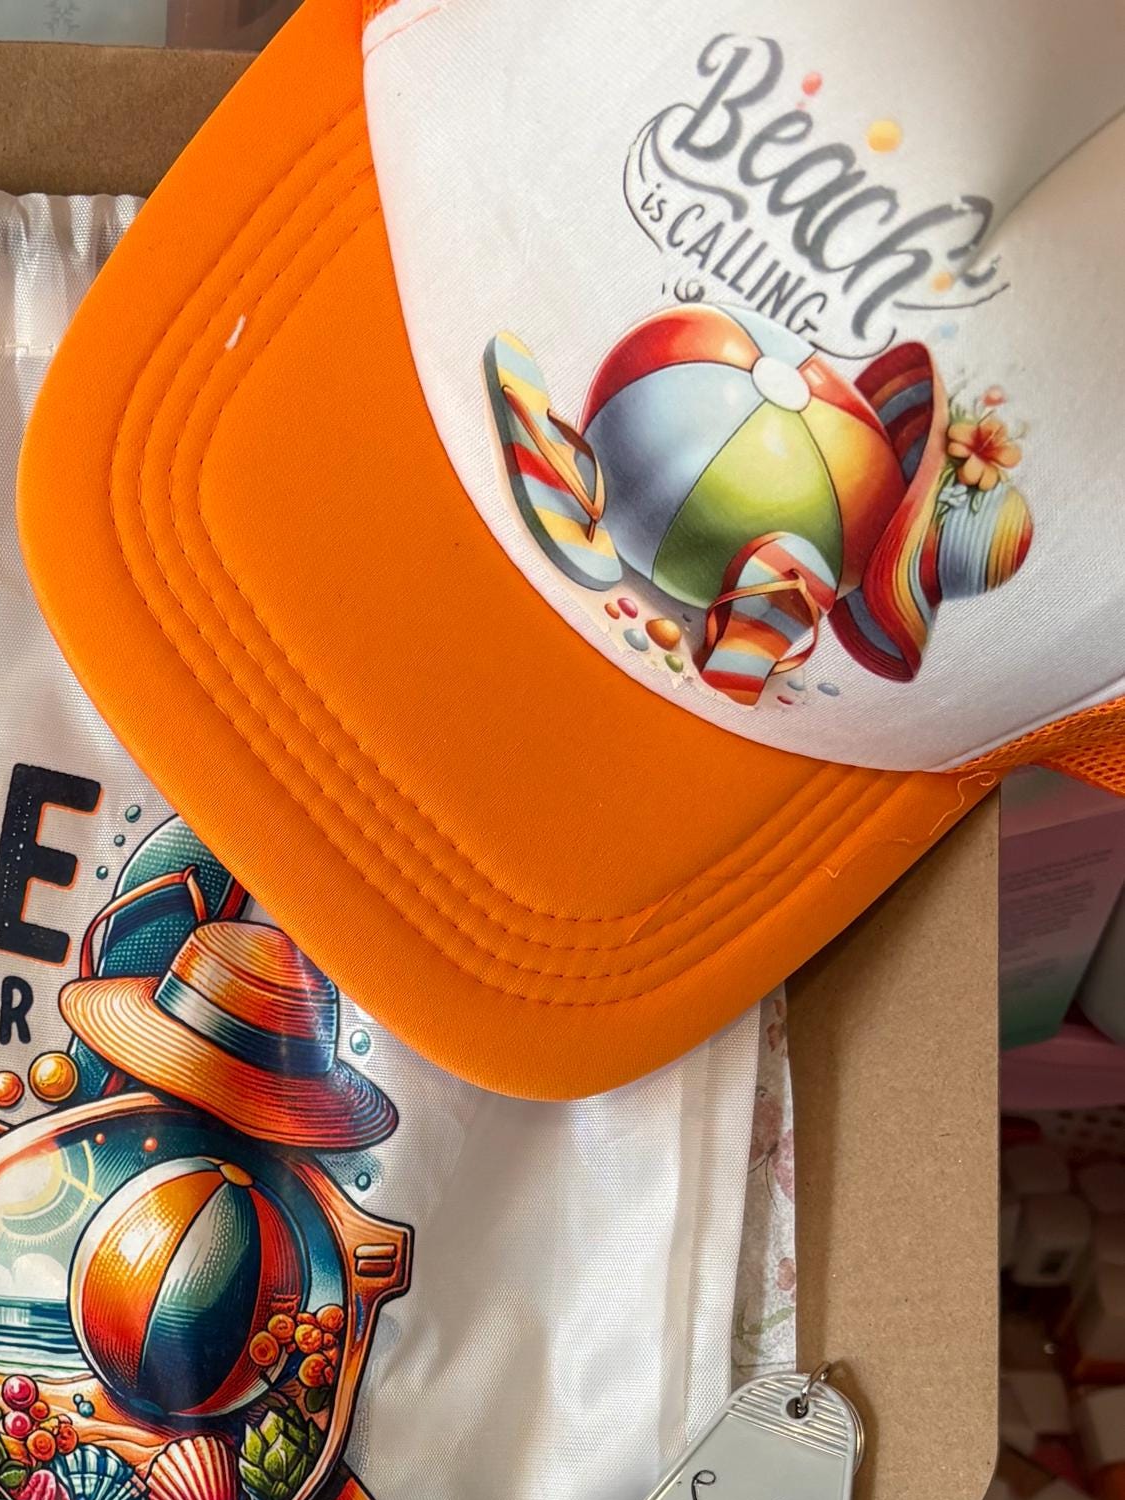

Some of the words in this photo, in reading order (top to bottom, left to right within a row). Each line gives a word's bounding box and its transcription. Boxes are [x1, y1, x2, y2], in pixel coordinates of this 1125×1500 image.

[641, 183, 667, 223] is
[666, 204, 827, 337] CALLING
[651, 33, 995, 342] Beach
